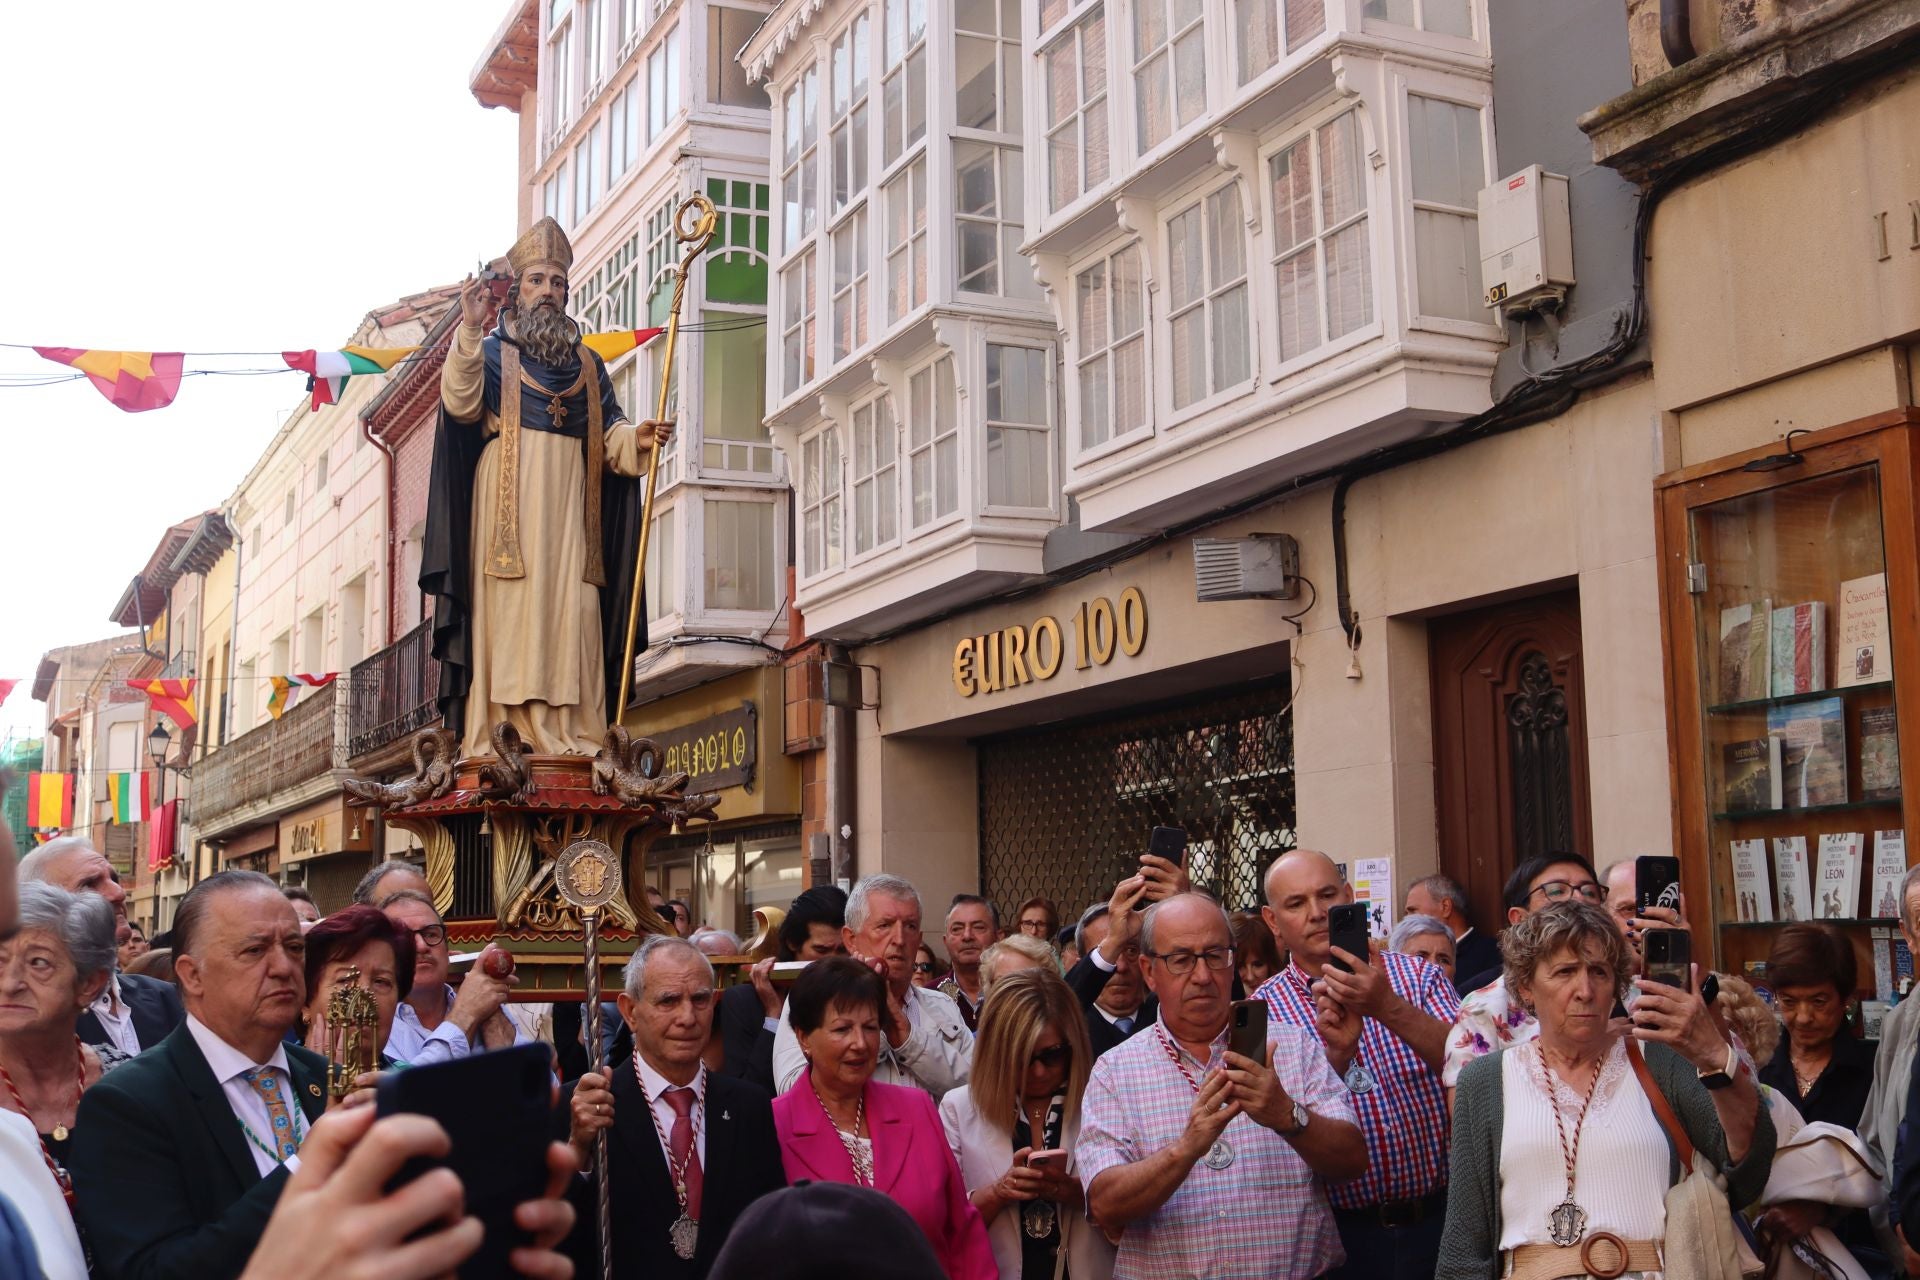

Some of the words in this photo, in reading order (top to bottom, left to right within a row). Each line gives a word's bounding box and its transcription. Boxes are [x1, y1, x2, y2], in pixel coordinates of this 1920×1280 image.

[1490, 284, 1507, 302] 01
[952, 615, 1064, 698] €URO
[1070, 585, 1149, 671] 100
[665, 725, 746, 778] MANOLO
[1736, 871, 1756, 879] NAVARRA
[1825, 867, 1845, 880] LEÓN
[1877, 865, 1903, 875] CASTILLA
